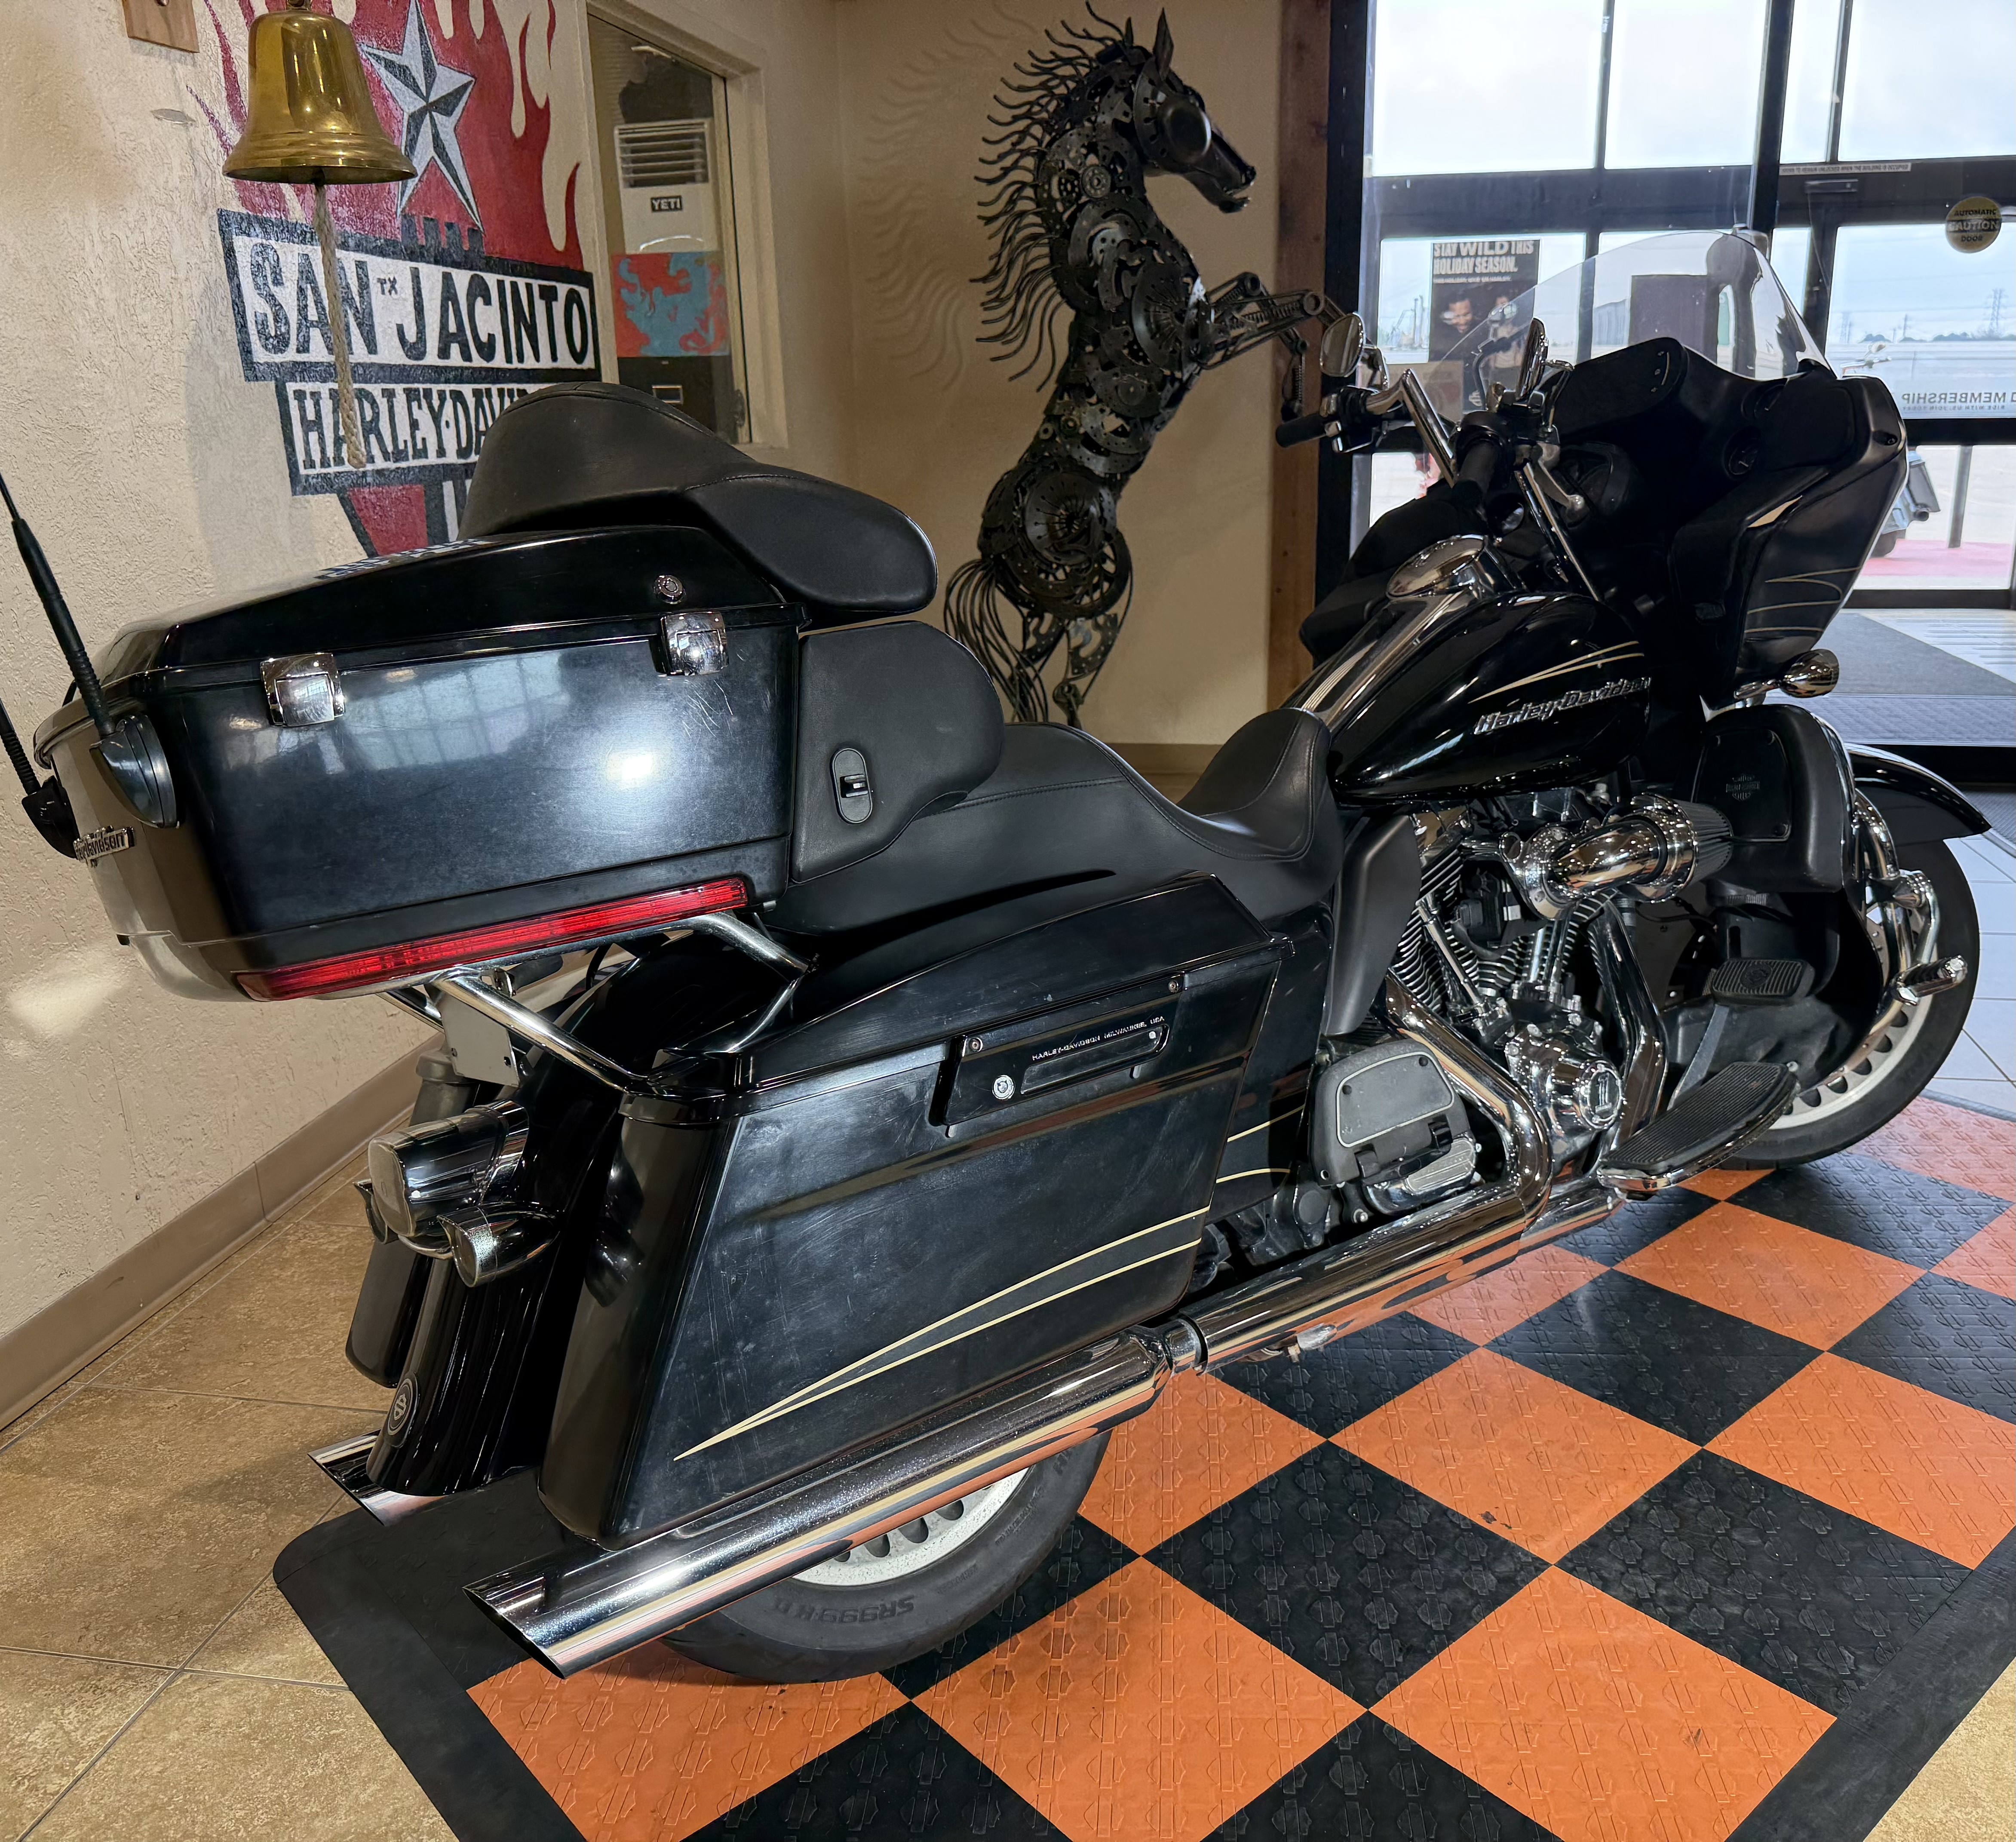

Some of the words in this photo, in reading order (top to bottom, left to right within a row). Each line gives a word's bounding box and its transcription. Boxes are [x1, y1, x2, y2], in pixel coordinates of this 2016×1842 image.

[653, 198, 680, 210] YETI
[1948, 220, 1998, 231] CAUTION
[1433, 243, 1458, 257] STAY
[1459, 241, 1510, 256] WILD
[1511, 240, 1534, 255] THIS
[1433, 256, 1475, 274] HOLIDAY
[250, 242, 378, 355] SAN
[377, 275, 398, 296] TX
[396, 267, 589, 365] JACINTO
[1032, 1035, 1101, 1061] HARLEY-DAVIDSON
[1150, 1016, 1165, 1024] USA
